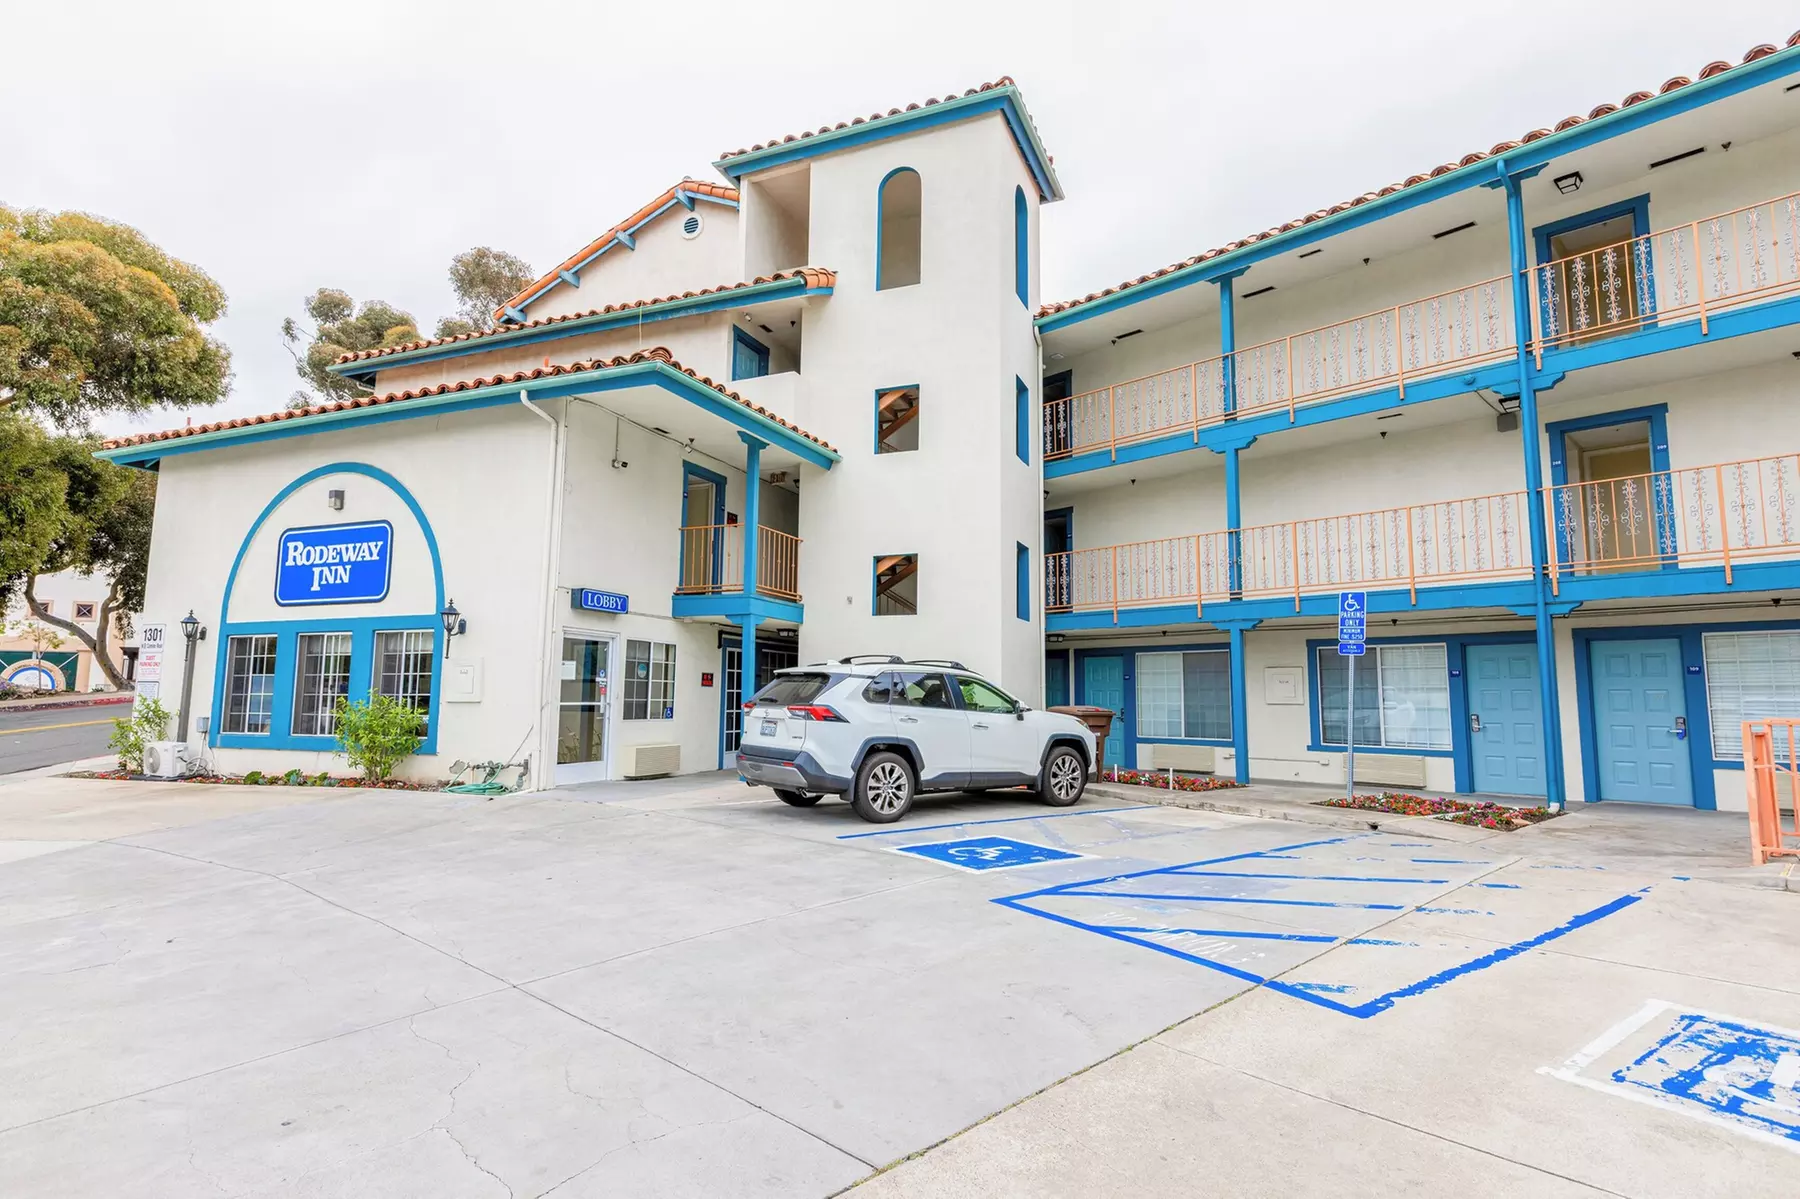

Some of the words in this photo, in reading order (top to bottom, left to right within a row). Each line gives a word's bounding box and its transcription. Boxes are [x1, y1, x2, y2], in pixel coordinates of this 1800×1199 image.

[285, 541, 383, 566] RODEWAY
[310, 565, 352, 591] INN
[587, 592, 624, 610] LOBBY
[143, 628, 163, 642] 1301
